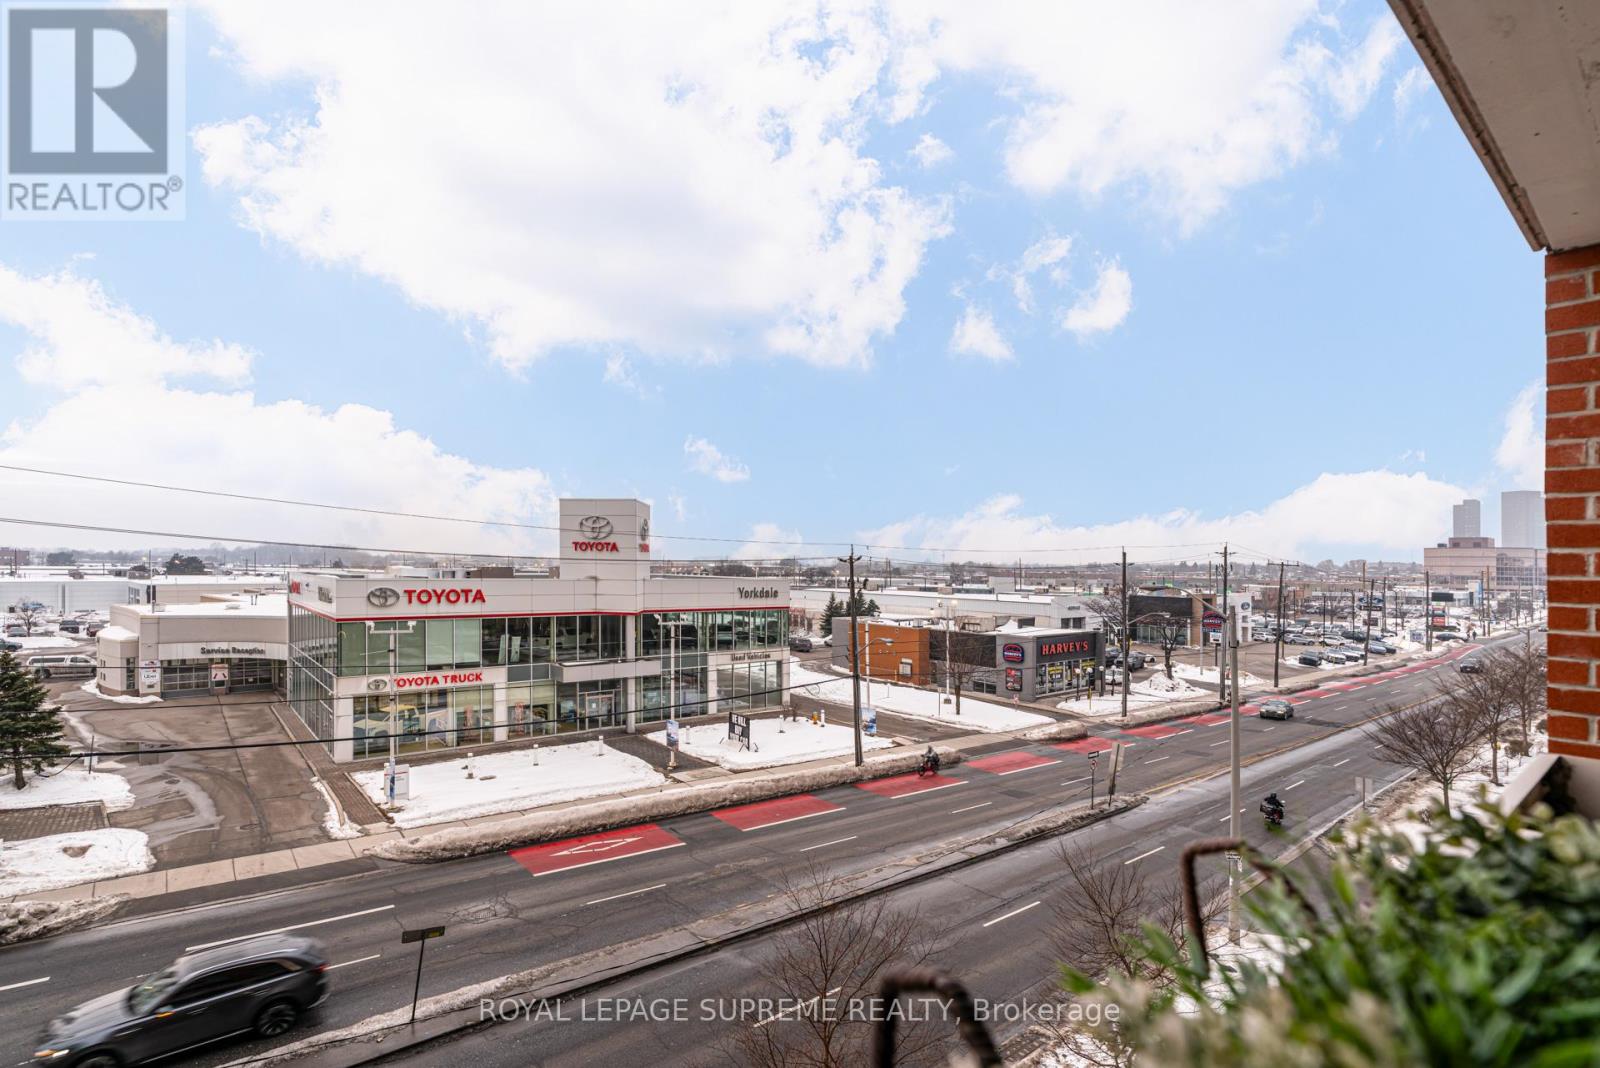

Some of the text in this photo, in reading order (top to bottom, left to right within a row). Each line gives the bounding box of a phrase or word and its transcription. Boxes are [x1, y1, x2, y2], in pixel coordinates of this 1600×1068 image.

[572, 541, 619, 552] TOYOTA
[404, 588, 486, 605] TOYOTA
[738, 587, 778, 598] Yorkdale
[1042, 640, 1089, 655] HARVEY'S
[441, 672, 483, 684] TRUCK
